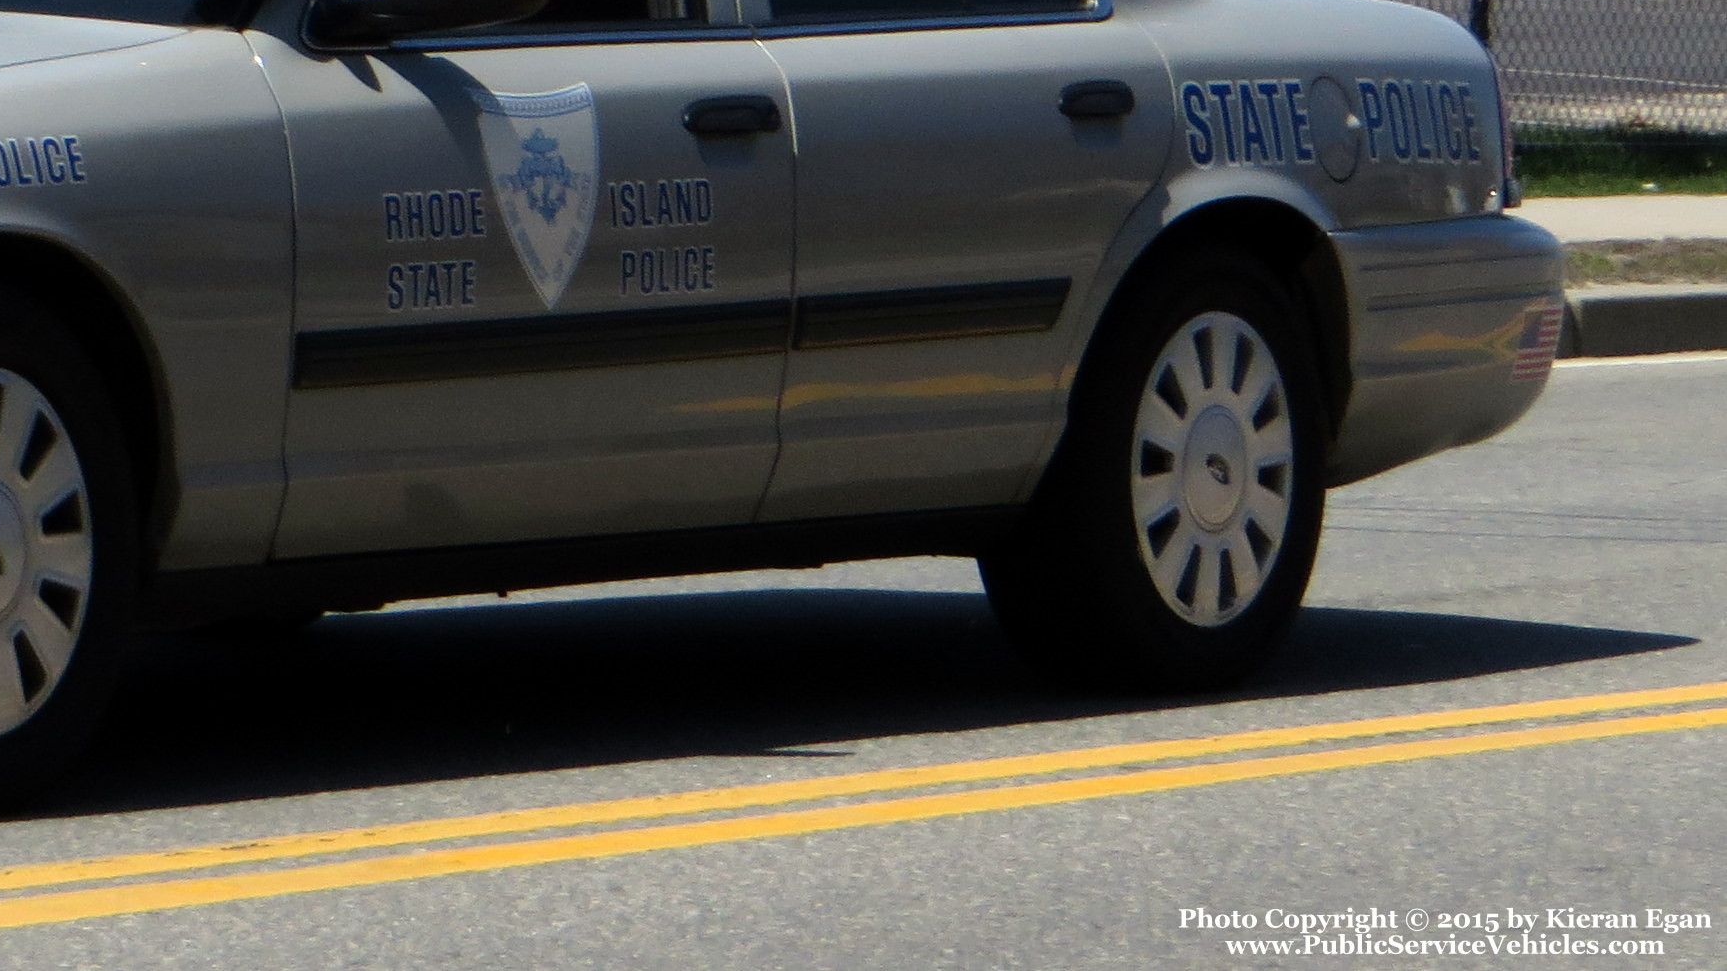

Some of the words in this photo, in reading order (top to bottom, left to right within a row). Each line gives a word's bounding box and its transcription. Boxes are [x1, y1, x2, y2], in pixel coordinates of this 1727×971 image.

[1182, 79, 1315, 169] STATE
[1357, 78, 1481, 164] POLICE
[382, 189, 486, 241] RHODE
[608, 178, 713, 229] ISLAND
[386, 261, 476, 310] STATE
[621, 246, 714, 296] POLICE
